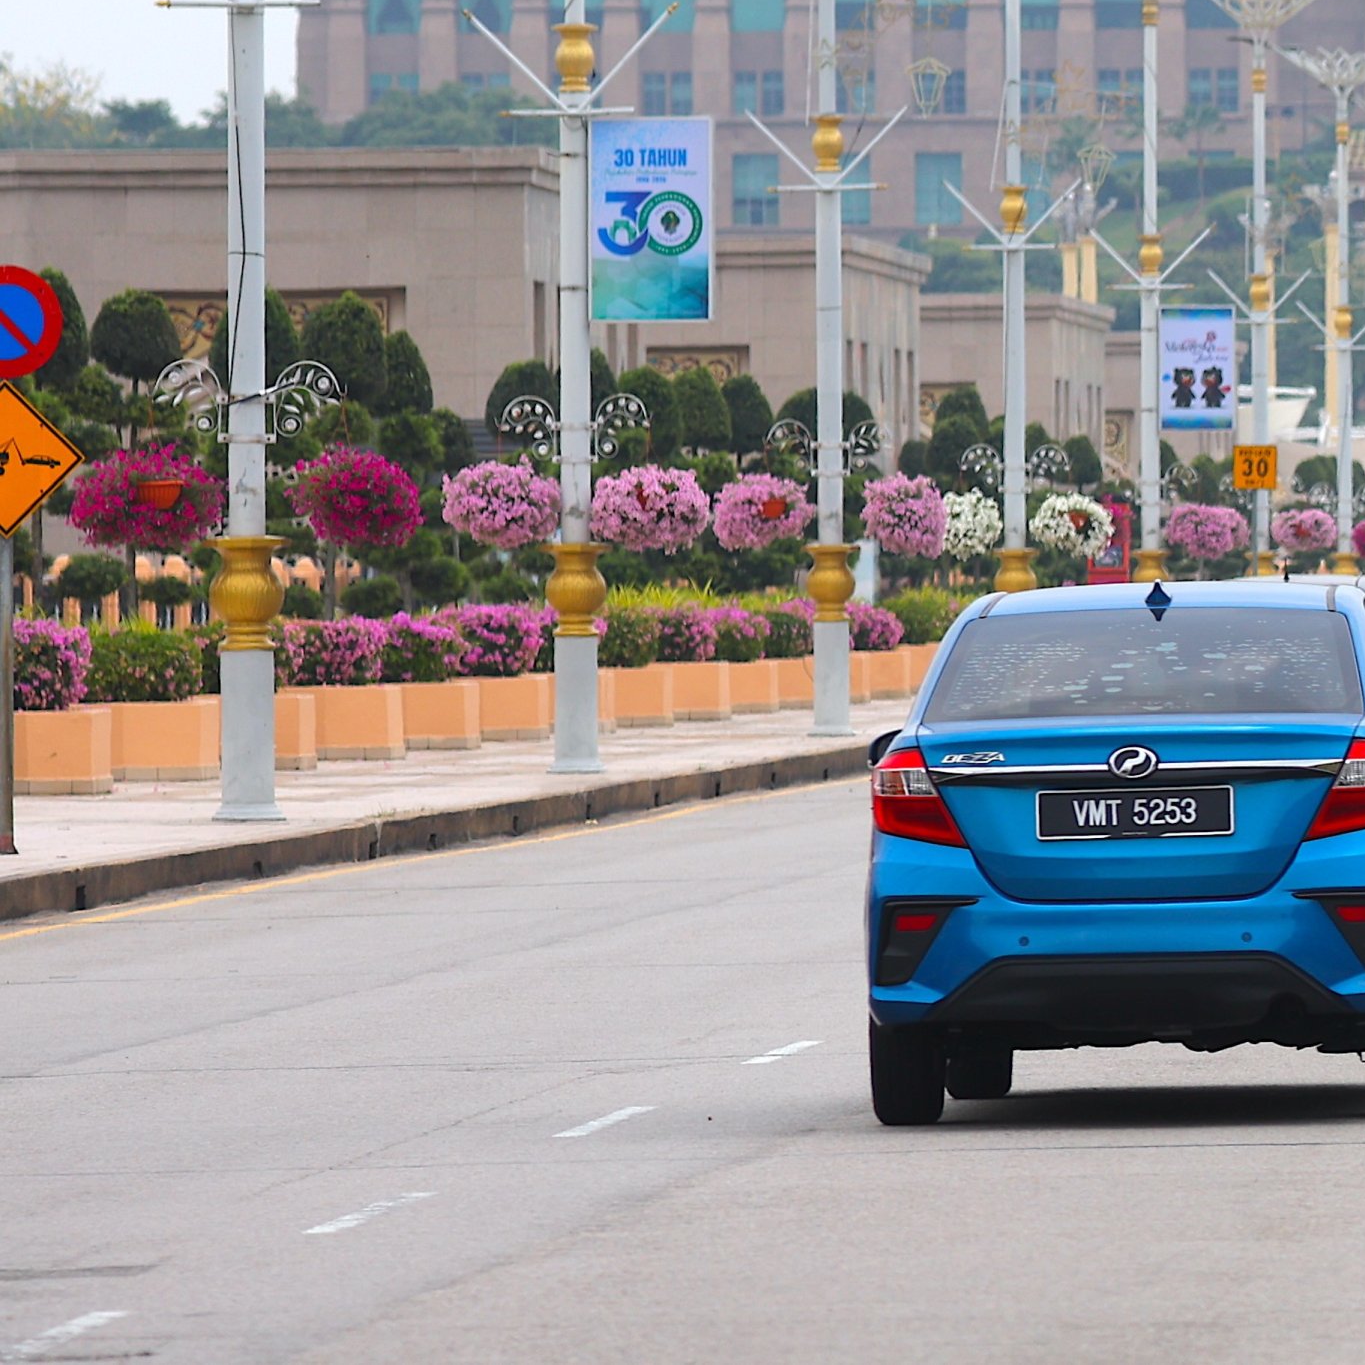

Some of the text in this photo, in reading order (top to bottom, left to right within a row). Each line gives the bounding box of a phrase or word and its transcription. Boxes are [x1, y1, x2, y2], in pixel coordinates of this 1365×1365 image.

[613, 149, 687, 167] 30 TAHUN
[1242, 458, 1268, 477] 30
[1072, 797, 1197, 827] VMT 5253
